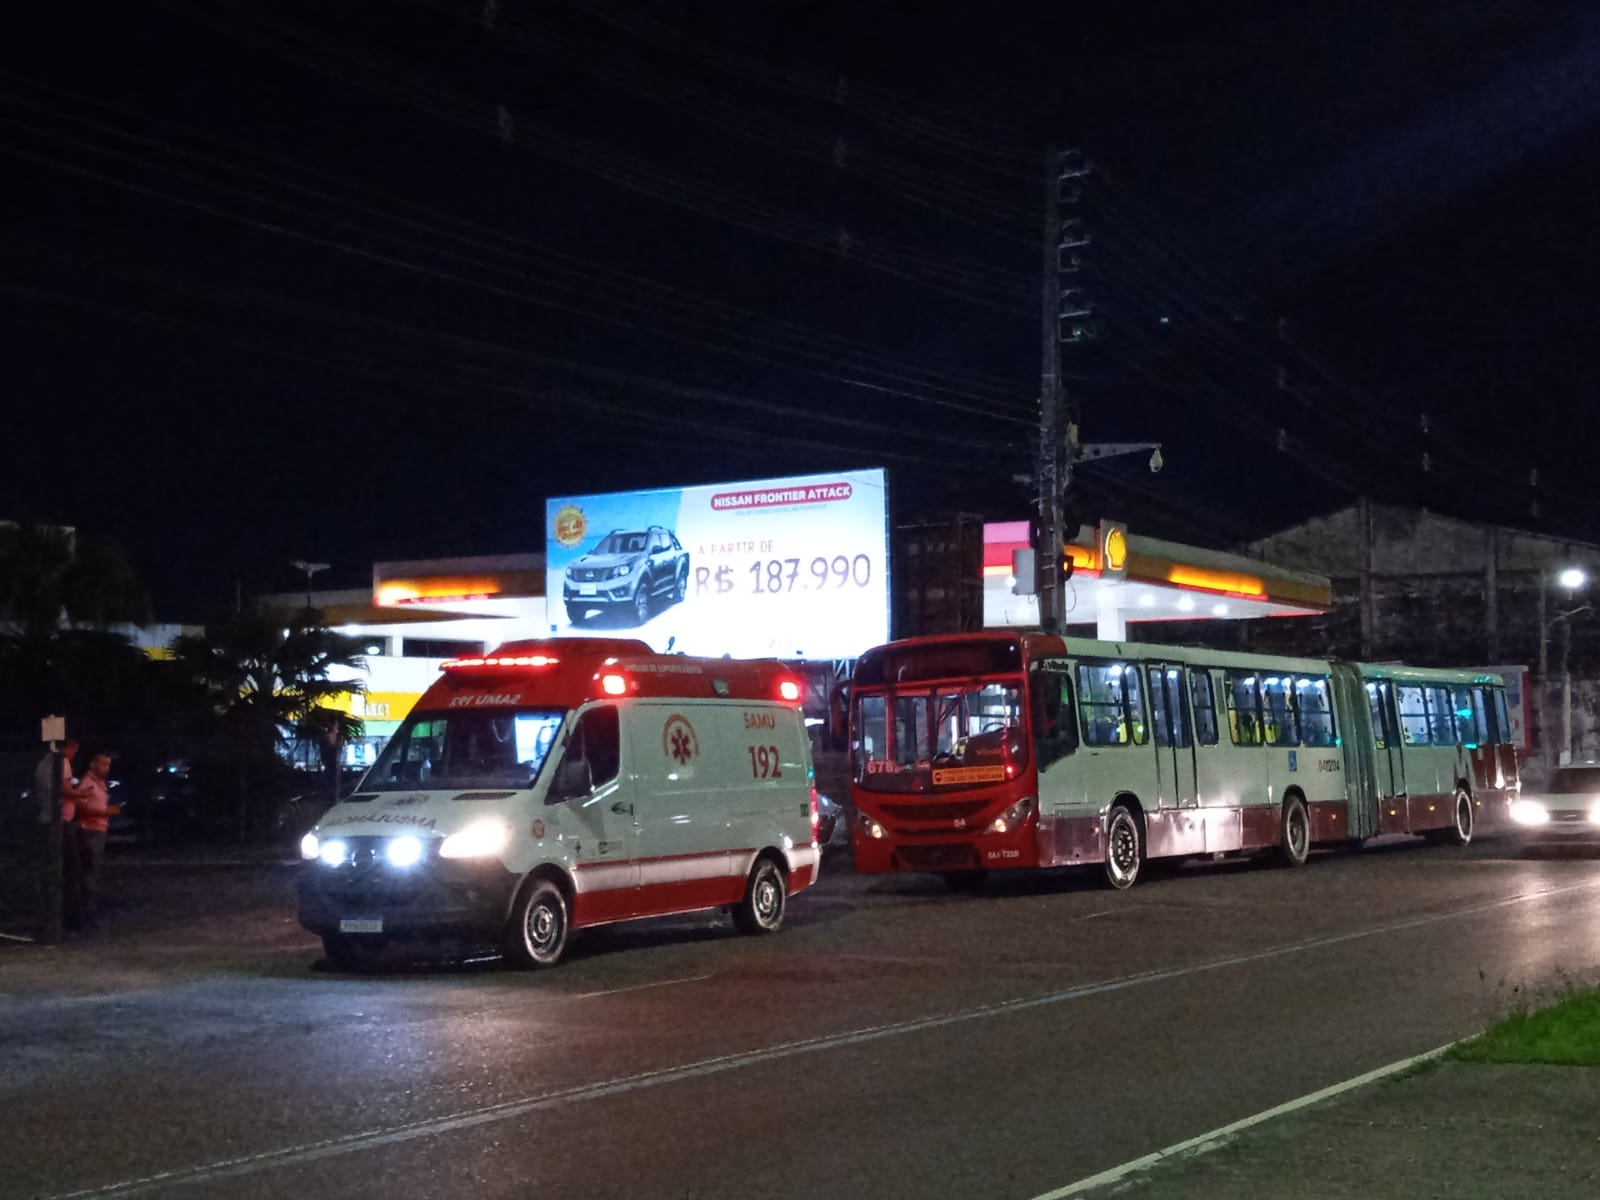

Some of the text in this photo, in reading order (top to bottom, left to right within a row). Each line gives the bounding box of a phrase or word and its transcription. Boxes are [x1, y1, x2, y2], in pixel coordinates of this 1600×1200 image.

[713, 486, 851, 508] NISSAN FRONTIER ATTACK
[699, 539, 773, 555] A PARTIR DE
[695, 553, 871, 596] R$ 187.990
[743, 712, 776, 730] SAMU
[748, 745, 783, 779] 192
